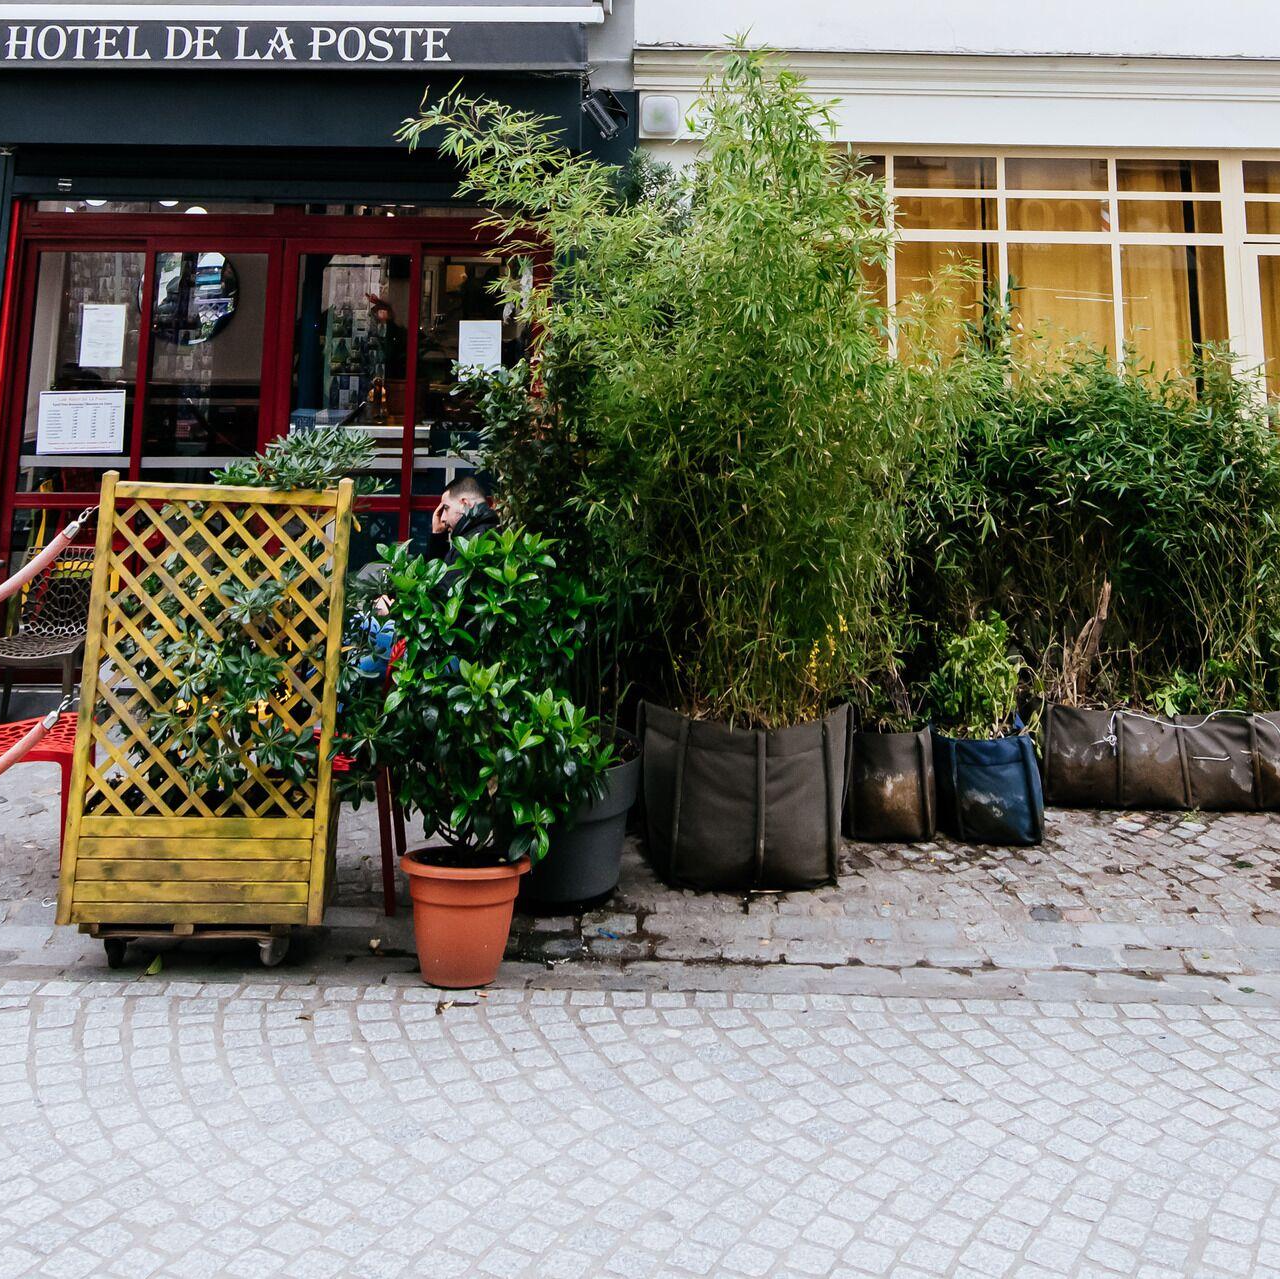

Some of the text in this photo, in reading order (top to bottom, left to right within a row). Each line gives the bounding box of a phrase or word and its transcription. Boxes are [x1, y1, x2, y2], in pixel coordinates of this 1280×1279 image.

[4, 25, 452, 62] HOTEL DE LA POSTE
